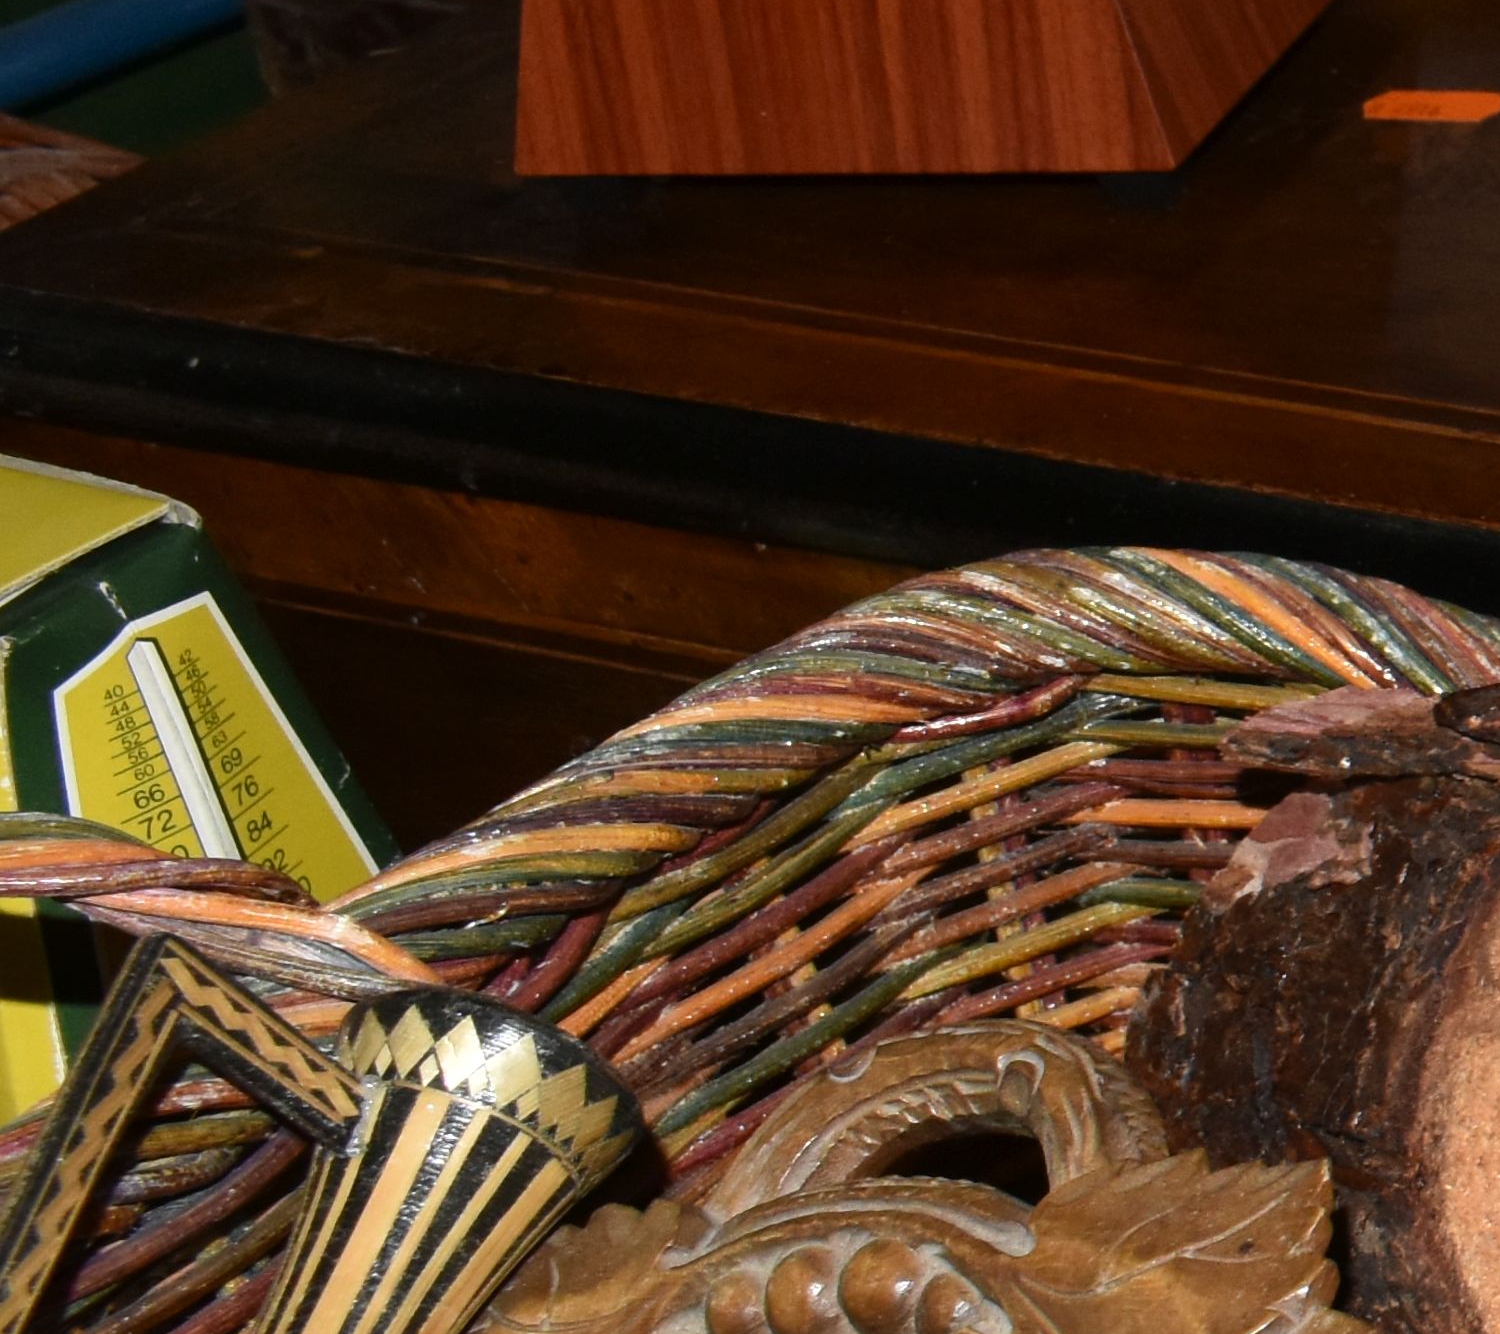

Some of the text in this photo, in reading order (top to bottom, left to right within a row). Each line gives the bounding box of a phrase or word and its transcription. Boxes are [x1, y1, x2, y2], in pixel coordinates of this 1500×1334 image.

[178, 649, 192, 667] 42
[186, 664, 200, 681] 46
[103, 684, 124, 701] 40
[191, 680, 206, 698] 50
[110, 701, 130, 717] 44
[198, 696, 213, 715] 54
[116, 716, 136, 732] 48
[204, 711, 220, 730] 58
[121, 732, 142, 750] 52
[211, 731, 228, 749] 63
[128, 746, 149, 764] 56
[220, 747, 243, 774] 69
[134, 764, 155, 781] 60
[133, 783, 165, 809] 66
[231, 774, 260, 806] 76
[137, 809, 176, 840] 72
[246, 811, 273, 842] 84
